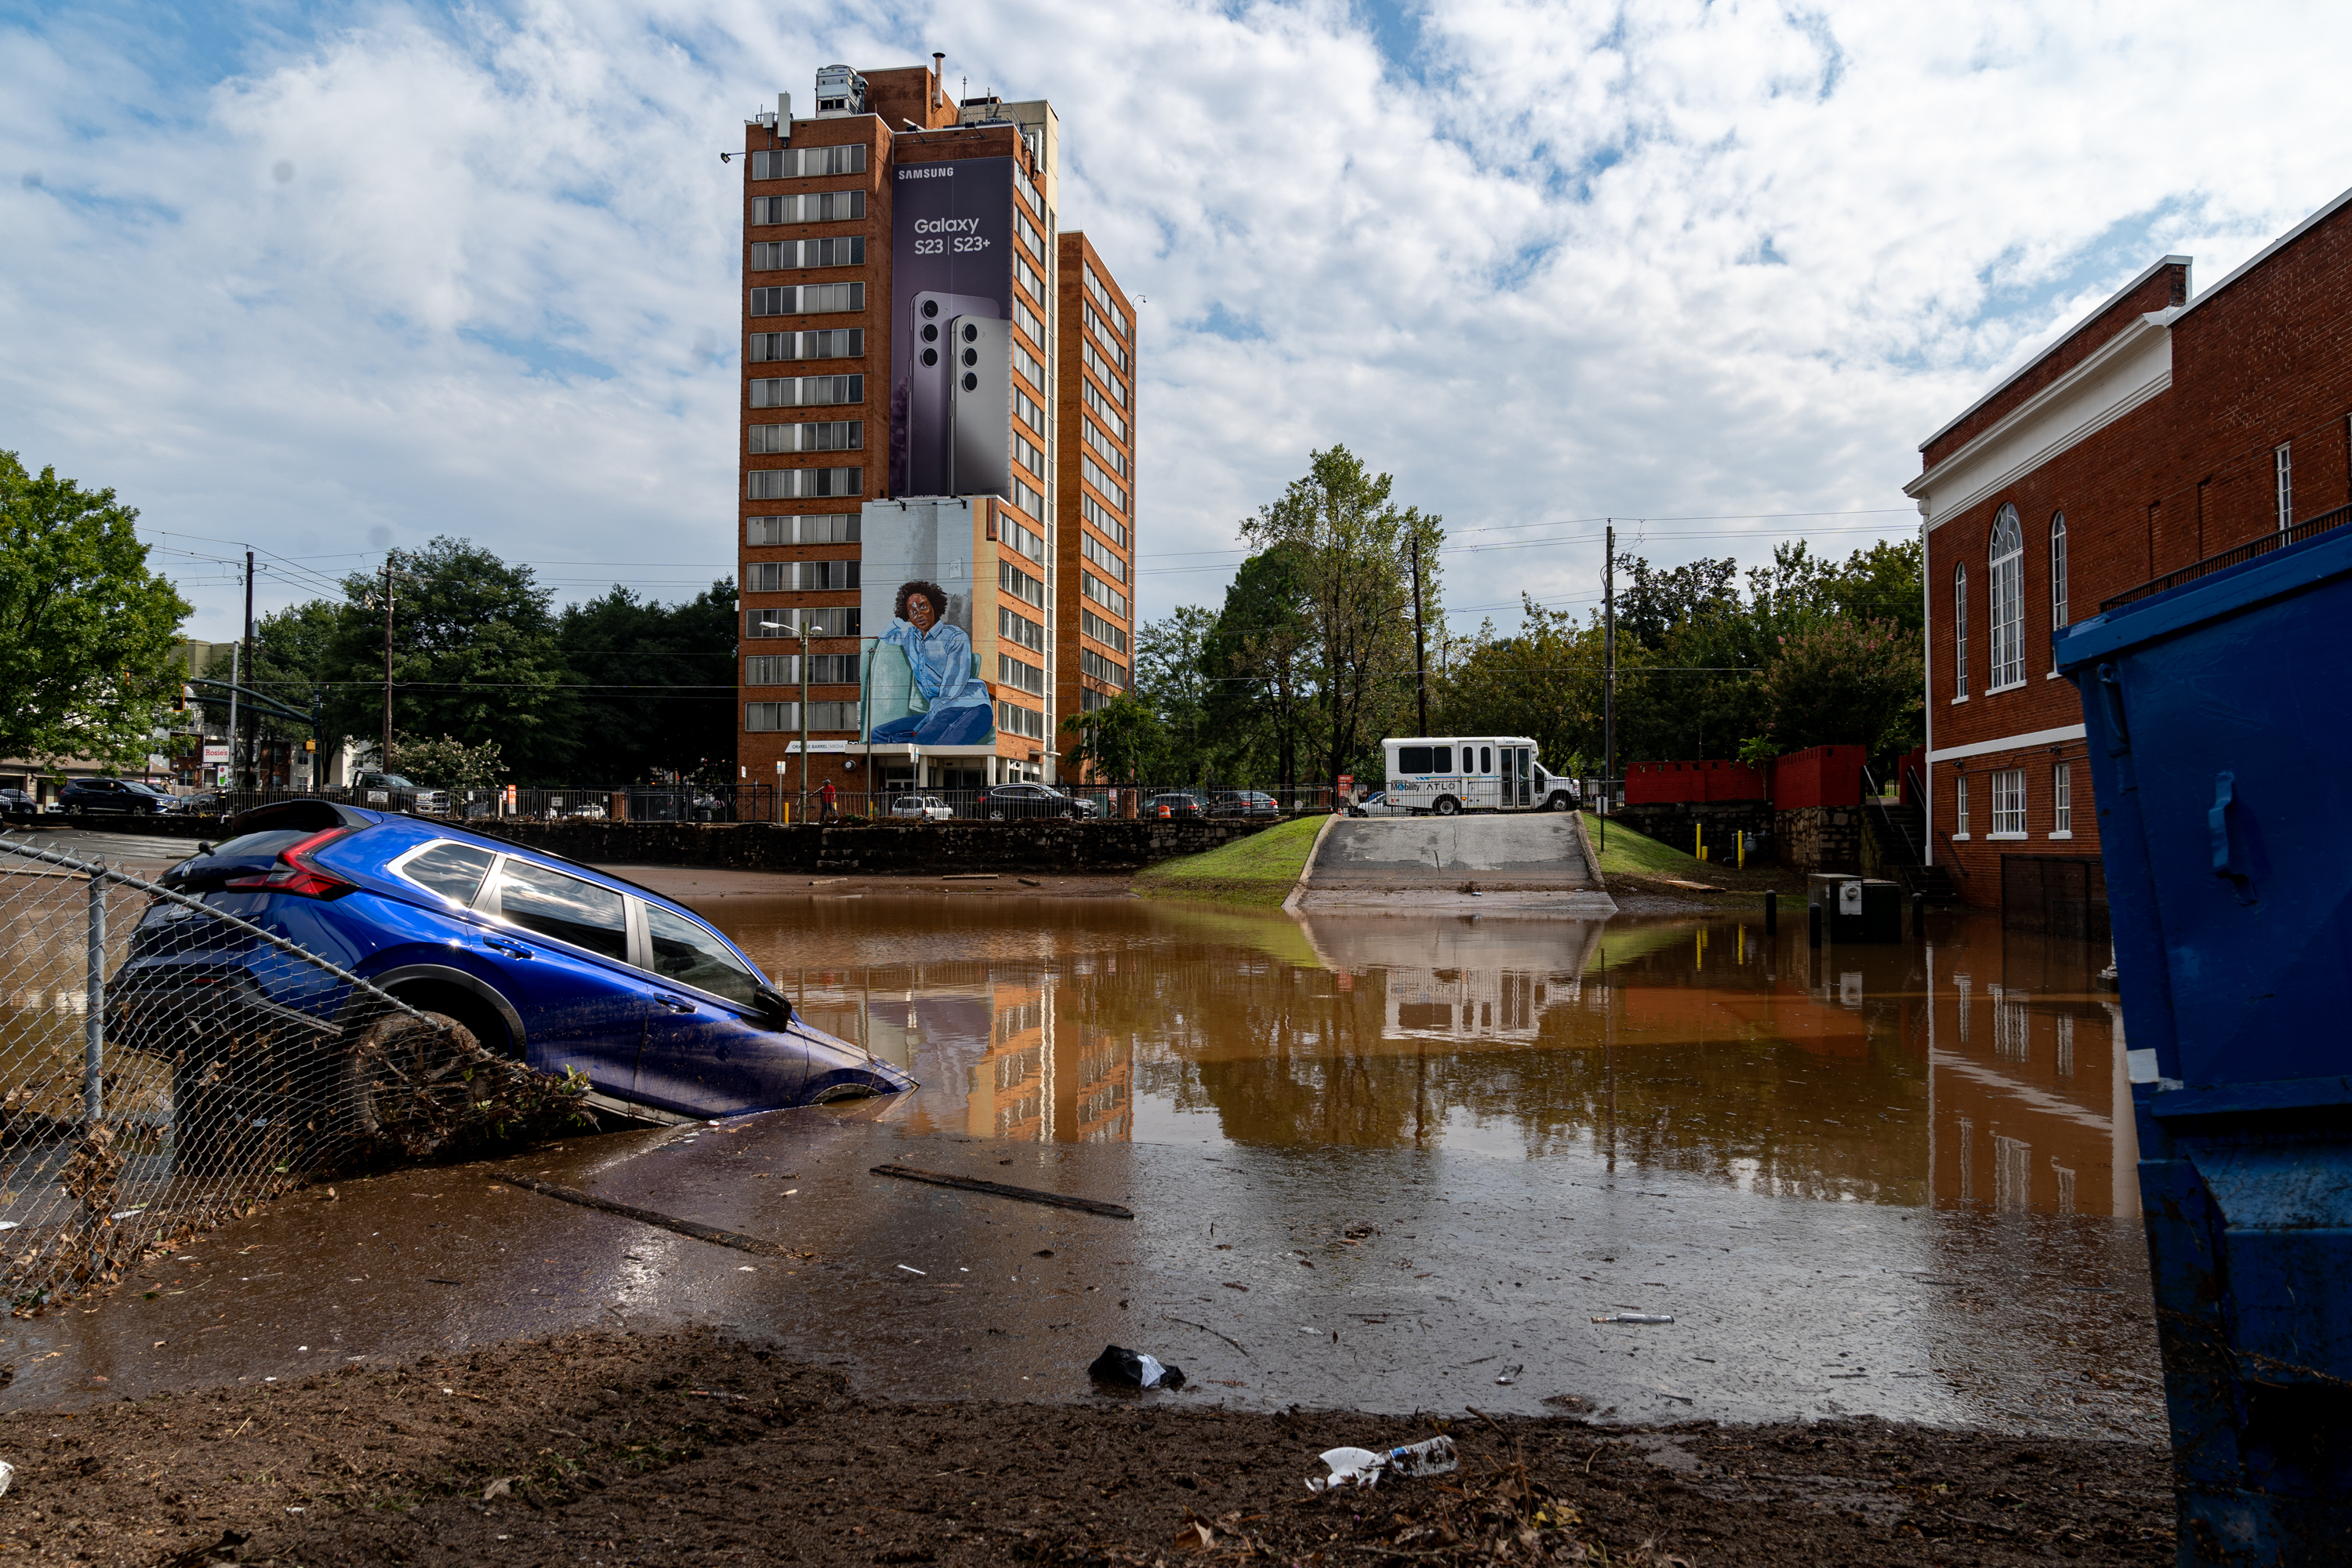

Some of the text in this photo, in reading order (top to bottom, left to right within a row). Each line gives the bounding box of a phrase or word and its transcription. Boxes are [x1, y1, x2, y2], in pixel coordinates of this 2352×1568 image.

[898, 167, 954, 180] SAMSUNG
[914, 217, 979, 234] Galaxy
[914, 236, 991, 255] S23 S23+
[981, 485, 1006, 495] SAMSUNG
